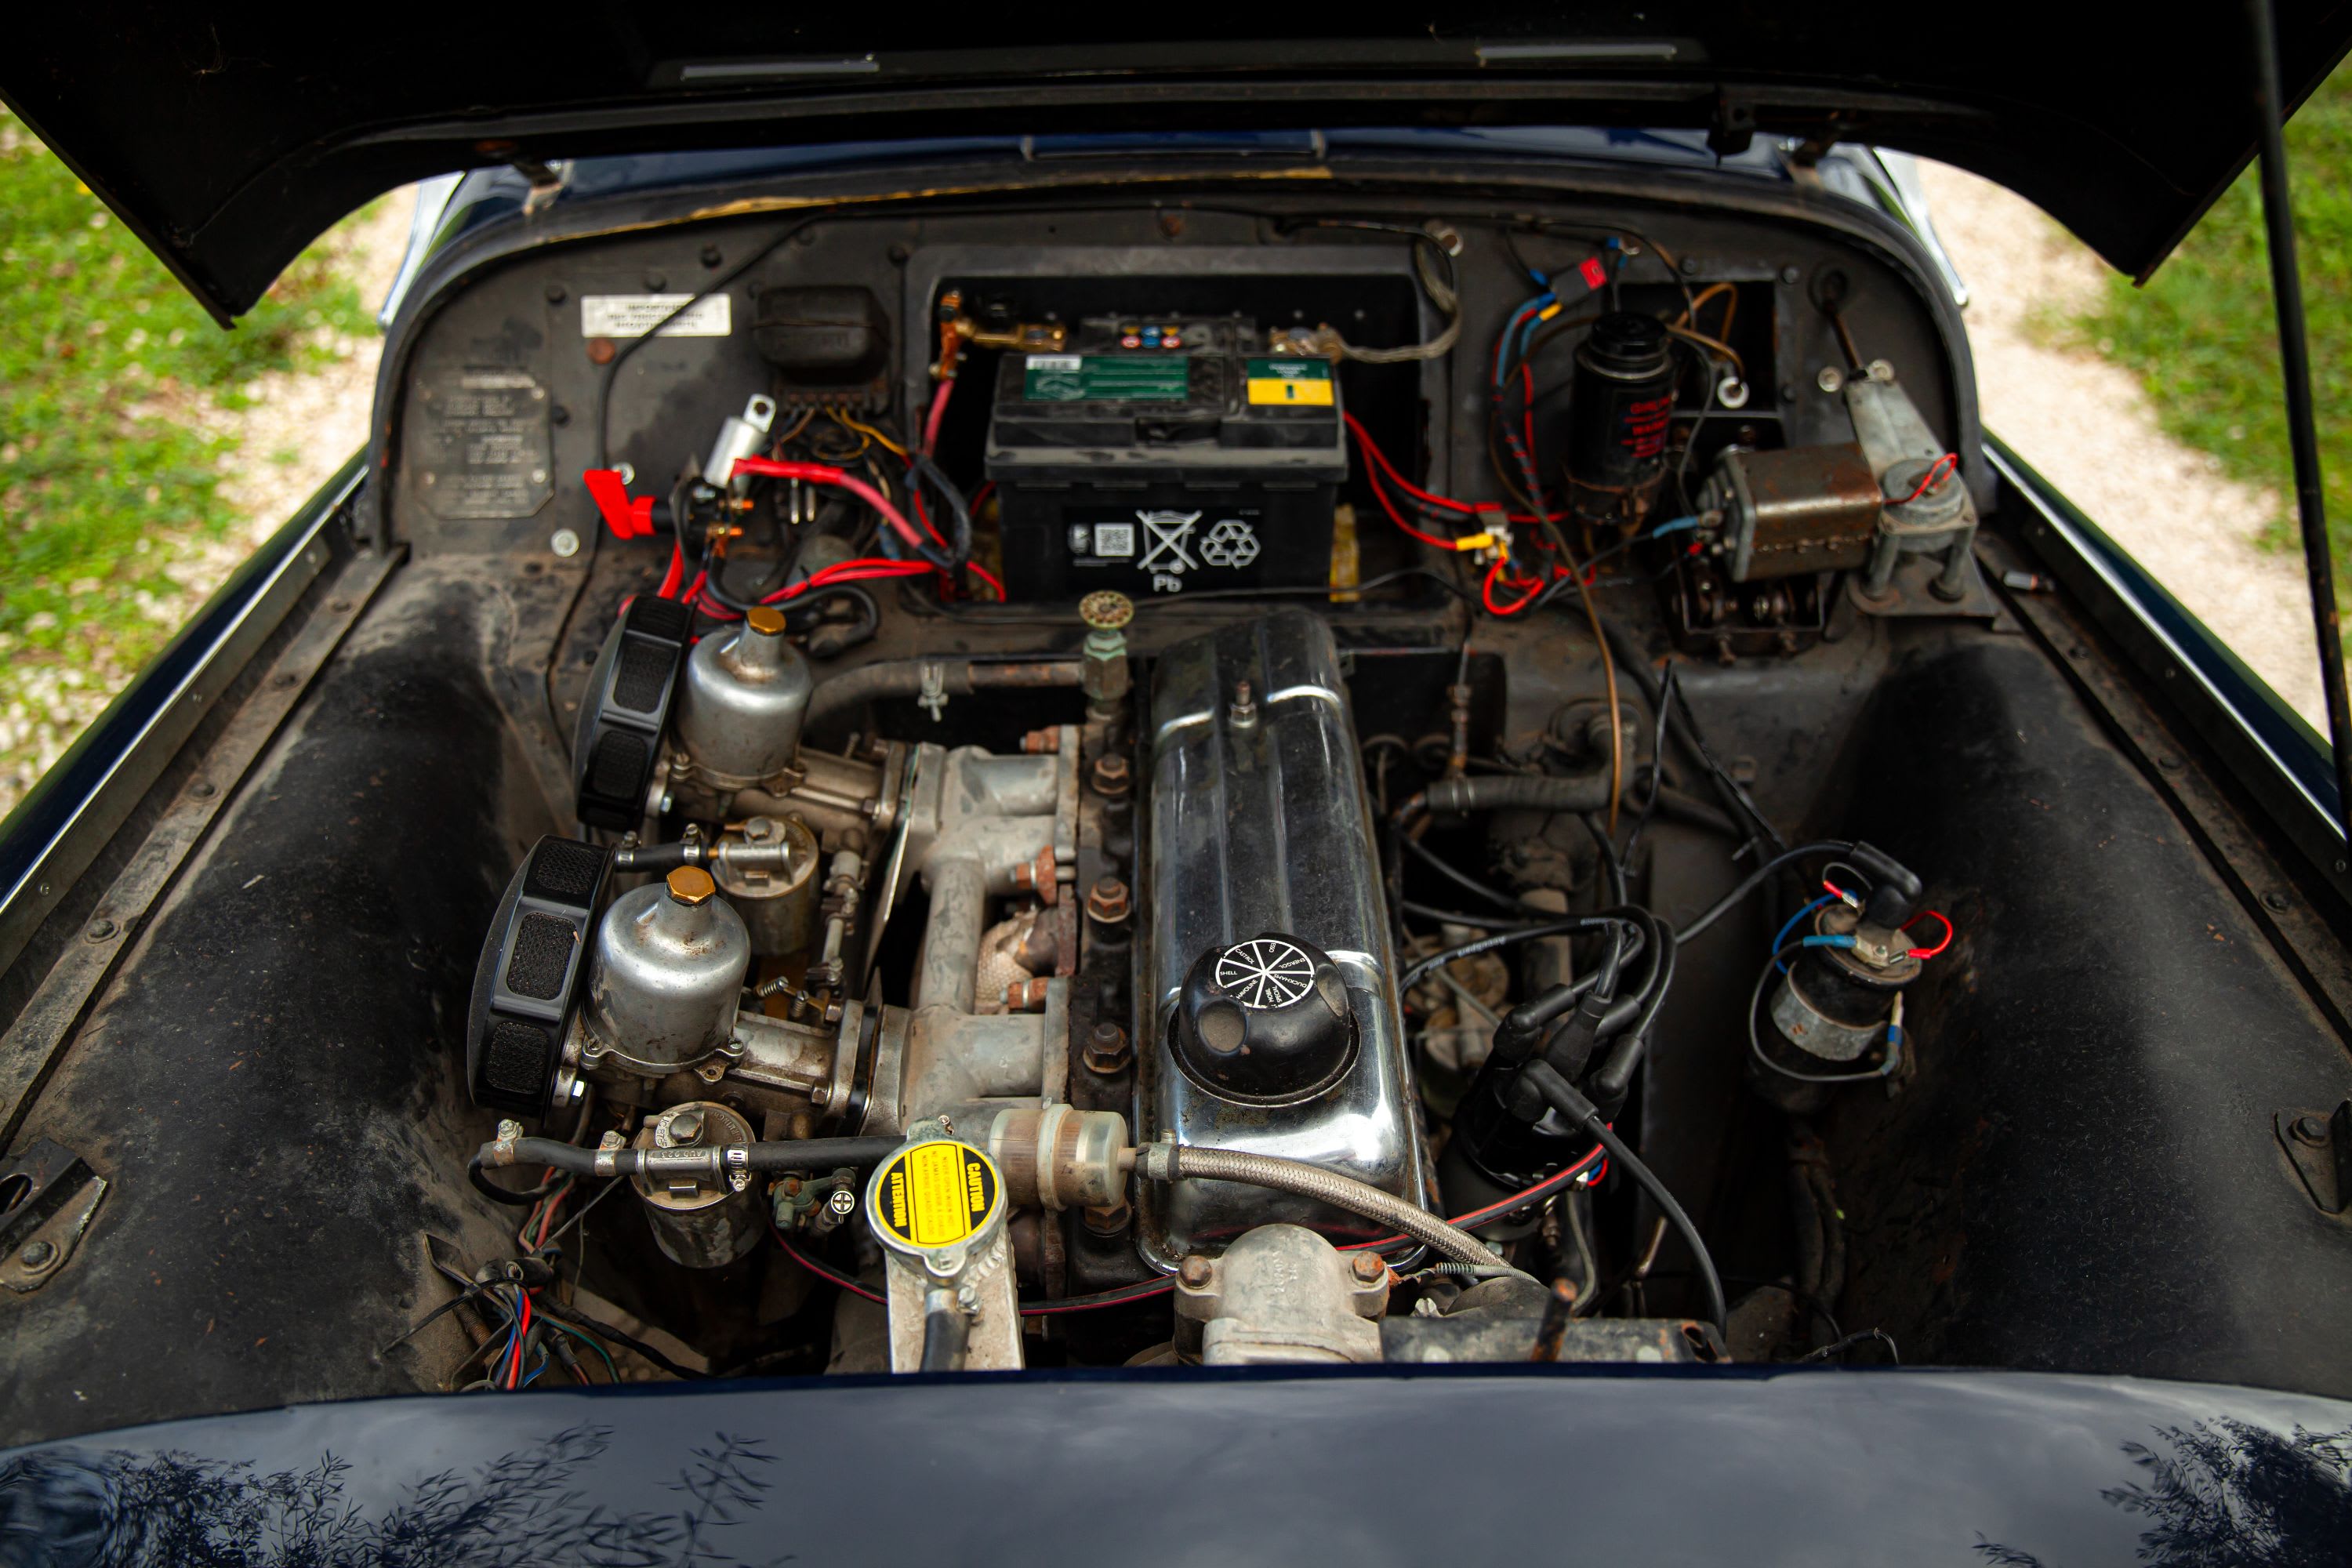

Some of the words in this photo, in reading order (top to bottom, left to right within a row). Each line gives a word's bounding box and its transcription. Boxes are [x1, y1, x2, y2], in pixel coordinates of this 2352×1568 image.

[1152, 575, 1182, 593] Pb
[1235, 948, 1255, 964] CASTROL
[1278, 957, 1306, 969] ENERGOL
[1236, 978, 1258, 1000] HAVOLINE
[1273, 973, 1307, 988] DUCKHAMS
[1272, 985, 1283, 1003] SPECIAL
[967, 1163, 985, 1211] CAUTION
[891, 1173, 907, 1227] ATTENTION
